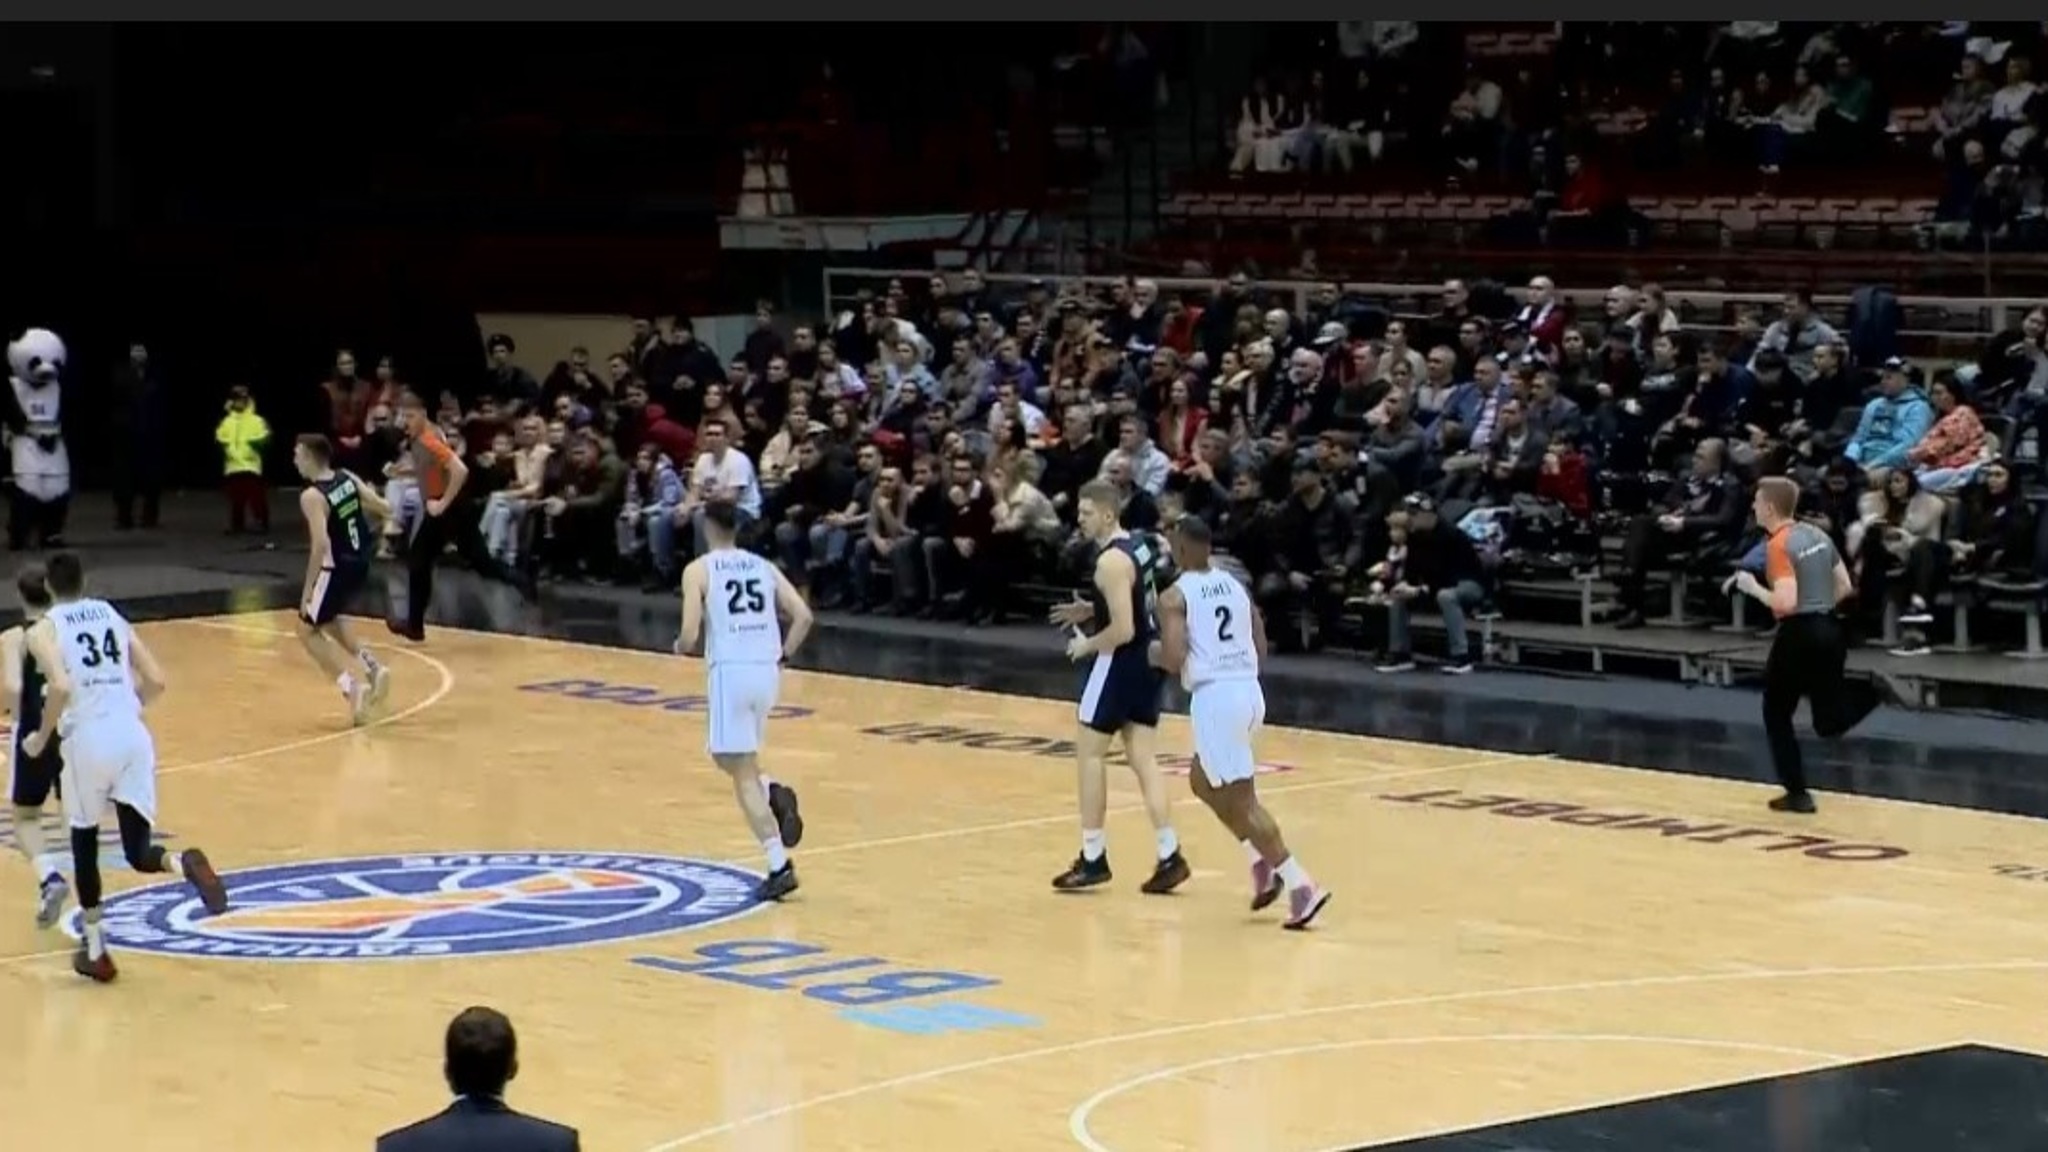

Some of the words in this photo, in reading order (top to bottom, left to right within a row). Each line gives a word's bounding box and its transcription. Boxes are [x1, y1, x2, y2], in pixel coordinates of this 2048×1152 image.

[725, 579, 765, 615] 25
[1215, 605, 1234, 642] 2
[76, 627, 121, 667] 34
[1380, 788, 1910, 861] OLIMPBET
[629, 940, 1003, 1006] ВТБ
